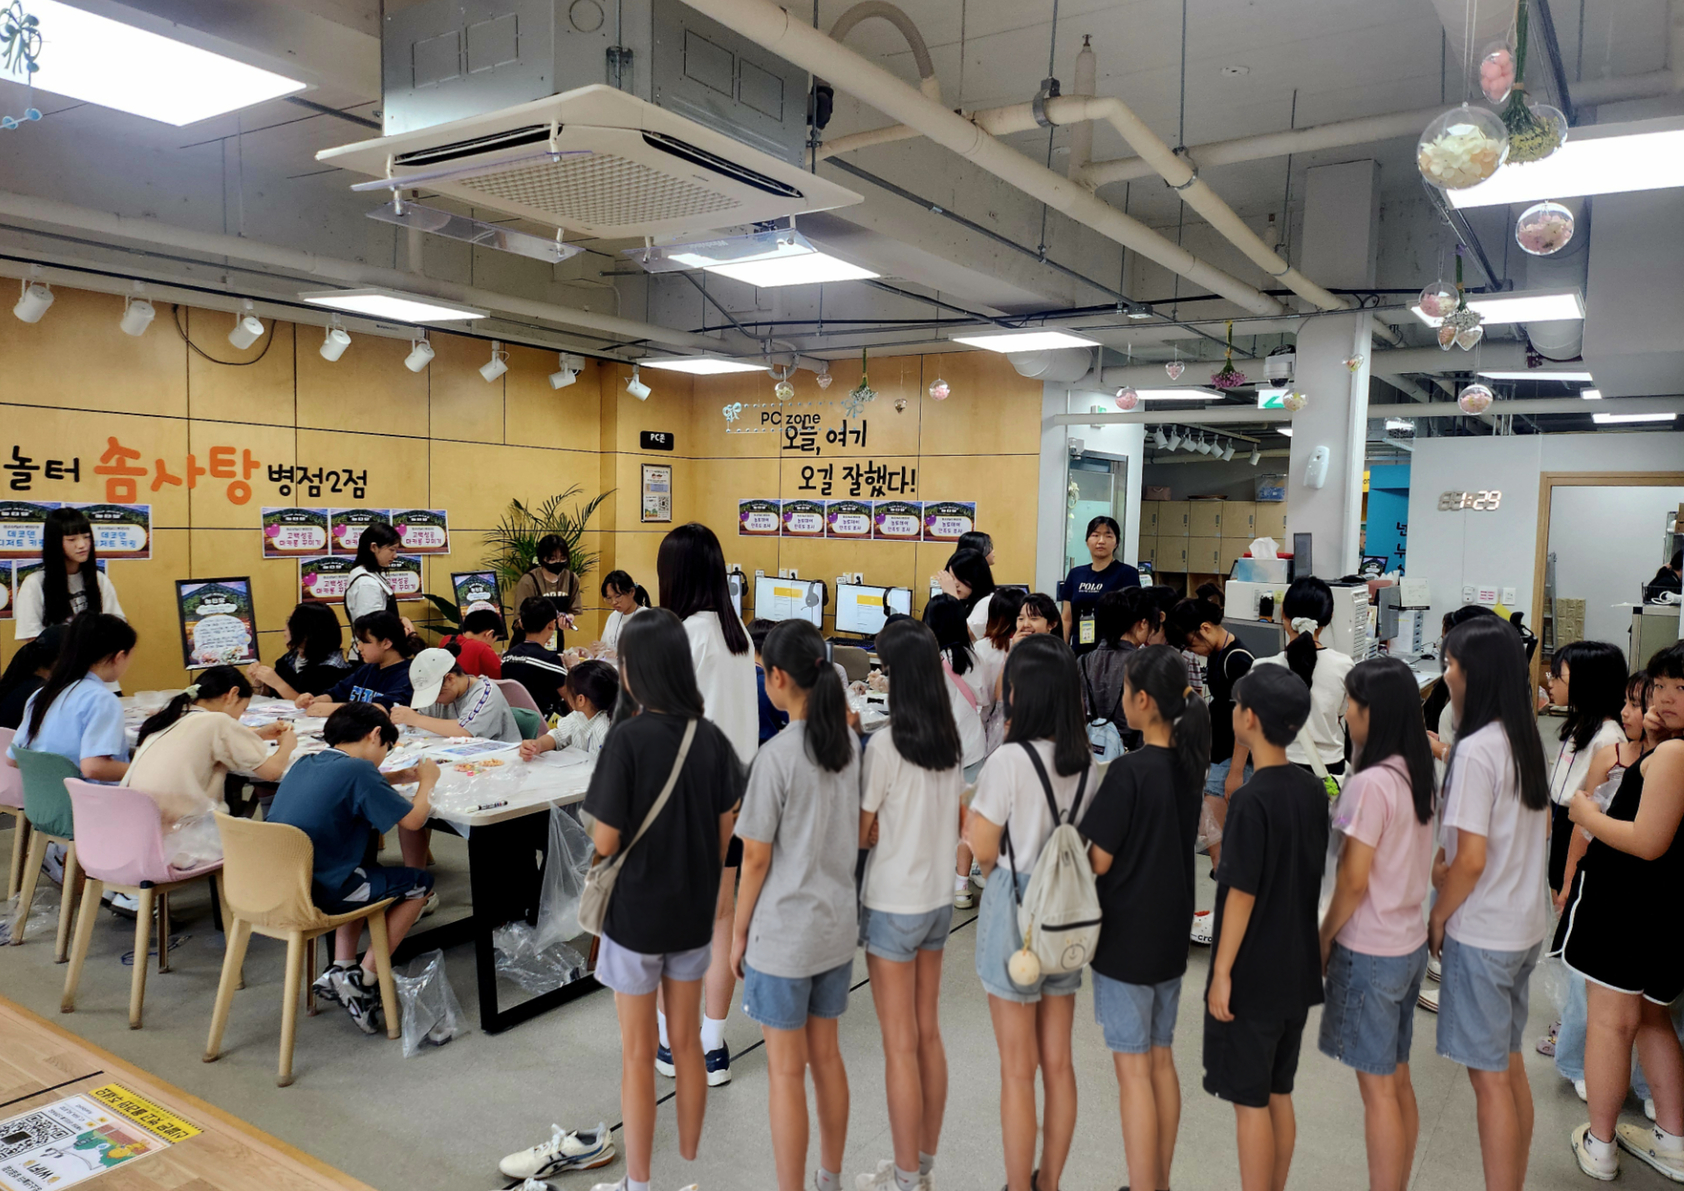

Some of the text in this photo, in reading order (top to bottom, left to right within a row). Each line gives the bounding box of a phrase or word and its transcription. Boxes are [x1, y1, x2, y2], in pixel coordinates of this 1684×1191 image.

[761, 411, 821, 425] PC zone
[826, 419, 867, 448] 여기
[3, 436, 368, 505] 놀터 솜사탕 병점2점
[798, 460, 916, 497] 오길 잘했다!
[1459, 490, 1502, 511] 1:29
[1078, 582, 1104, 590] POLO
[26, 1163, 54, 1180] WIFI
